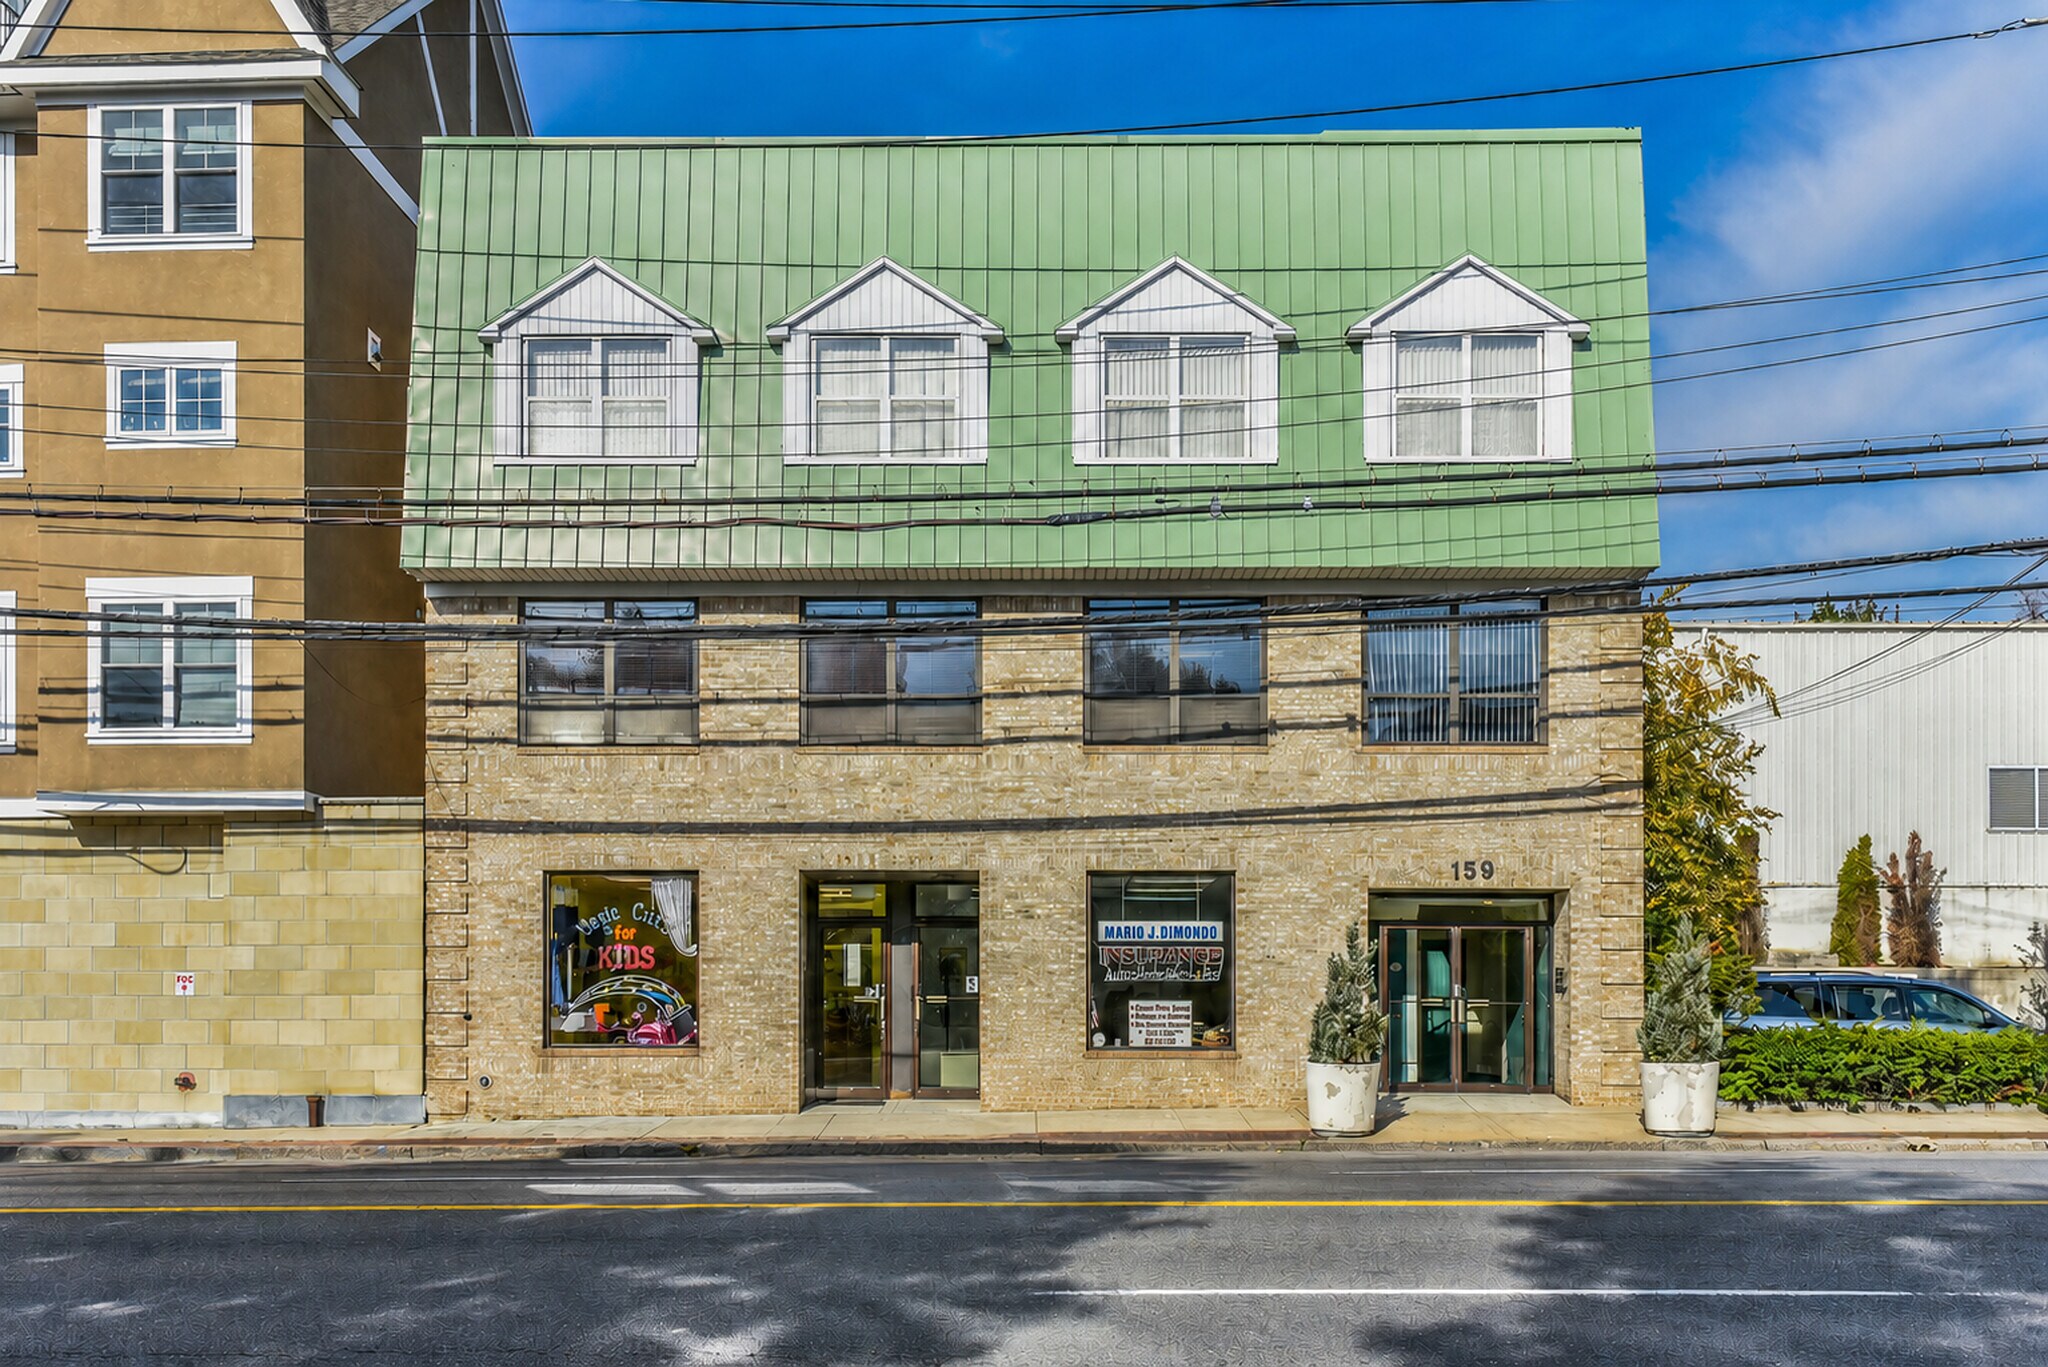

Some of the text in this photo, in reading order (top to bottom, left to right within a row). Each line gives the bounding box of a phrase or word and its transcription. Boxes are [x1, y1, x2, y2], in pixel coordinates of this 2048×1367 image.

[1451, 860, 1494, 880] 159
[614, 924, 637, 940] for
[1104, 925, 1144, 939] MARIO
[598, 943, 656, 970] KIDS
[1099, 946, 1224, 965] INSURANCE
